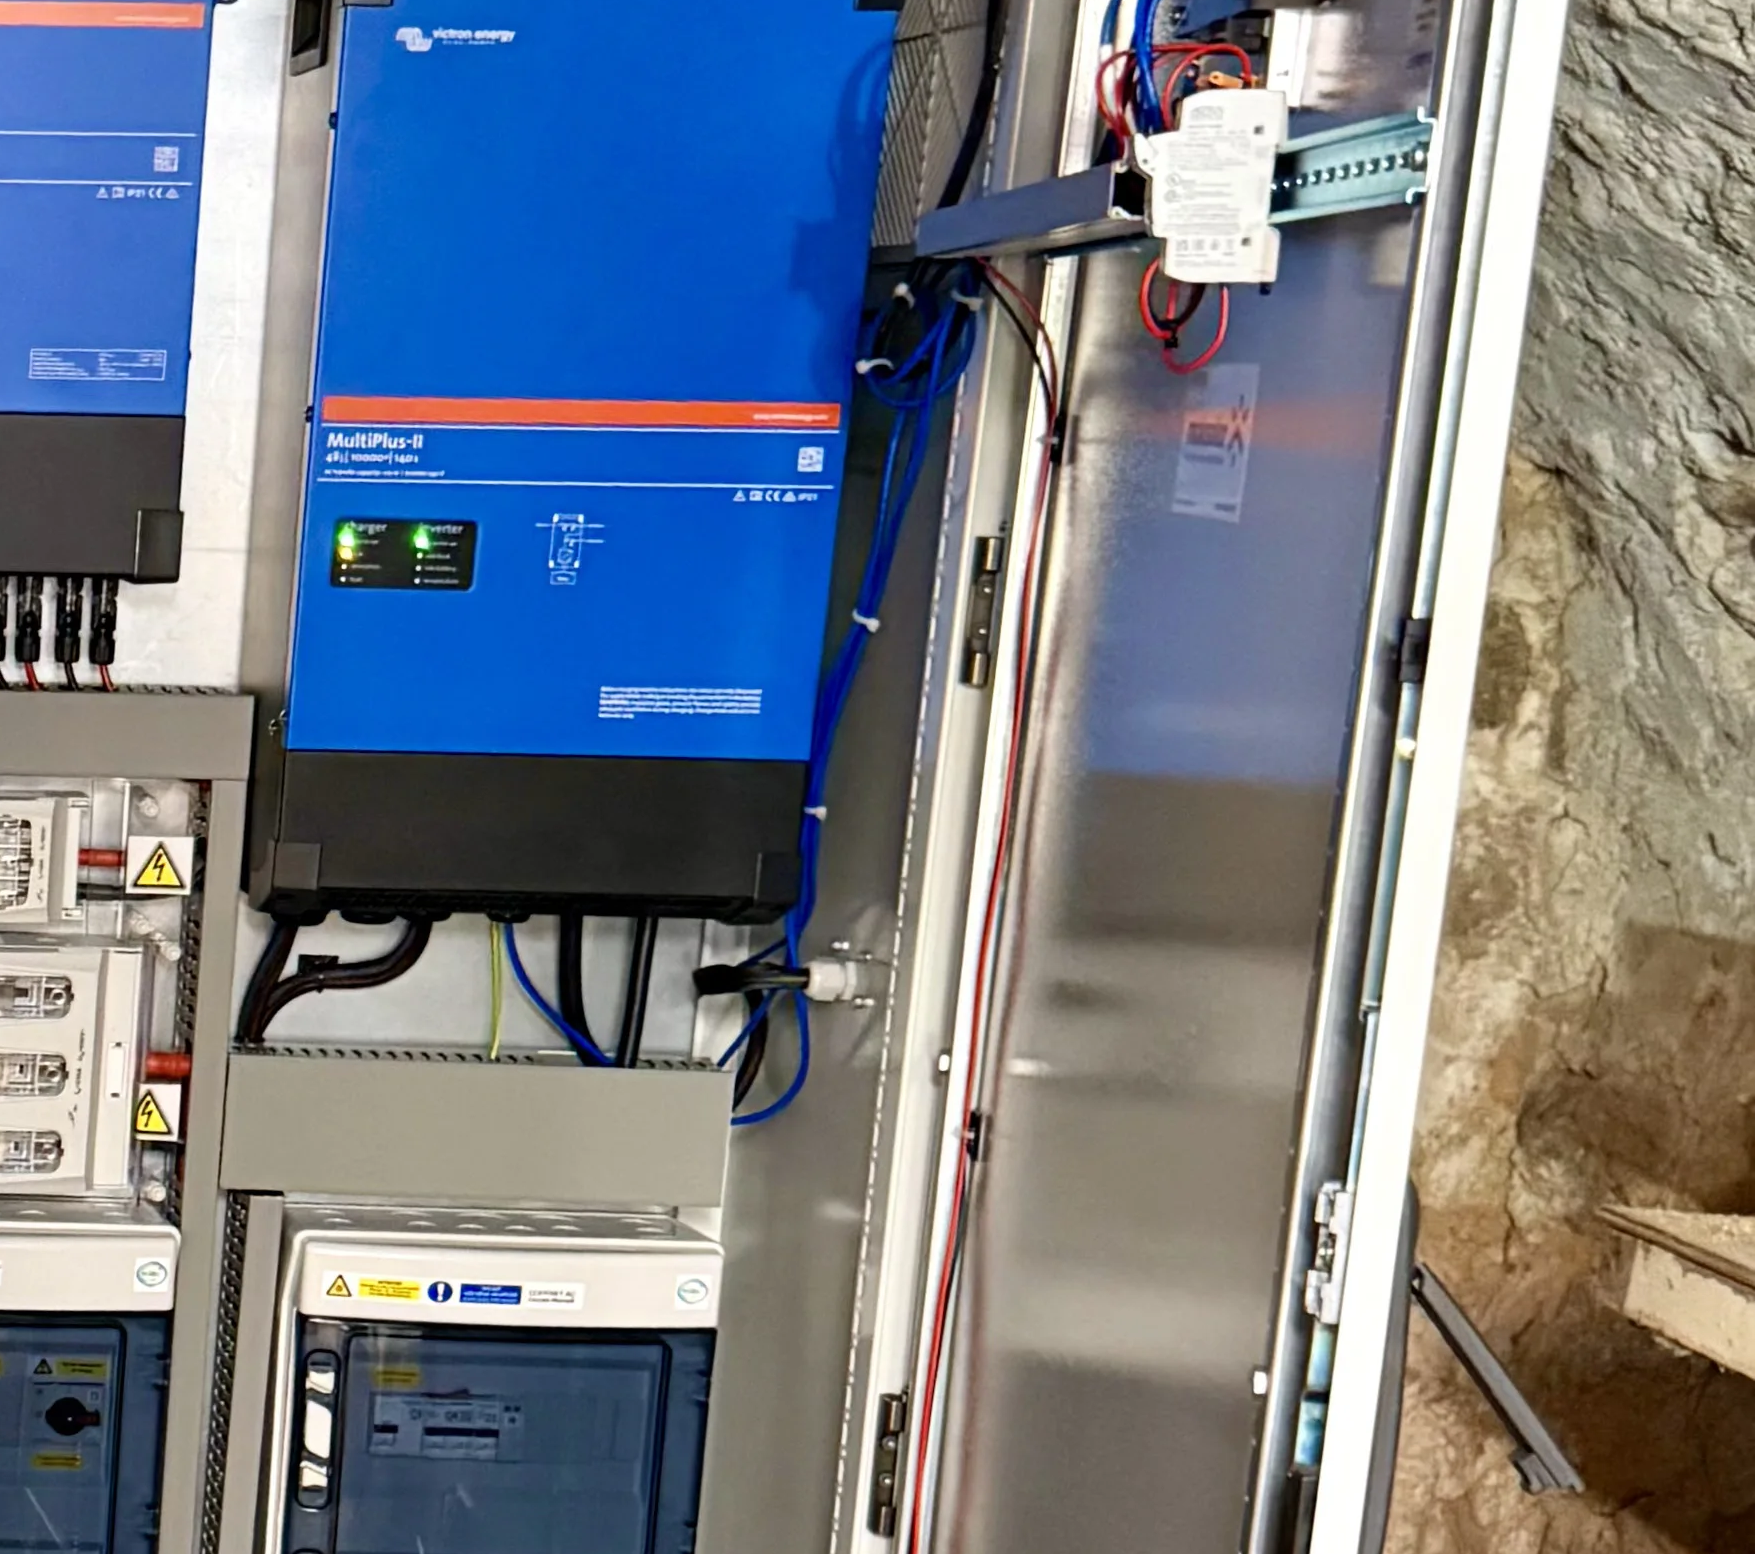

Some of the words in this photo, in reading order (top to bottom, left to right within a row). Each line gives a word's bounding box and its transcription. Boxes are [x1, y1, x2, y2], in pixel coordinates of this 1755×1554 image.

[432, 27, 472, 39] victron
[474, 30, 516, 42] energy
[326, 432, 424, 449] MultiPlus-II
[345, 521, 388, 535] harger
